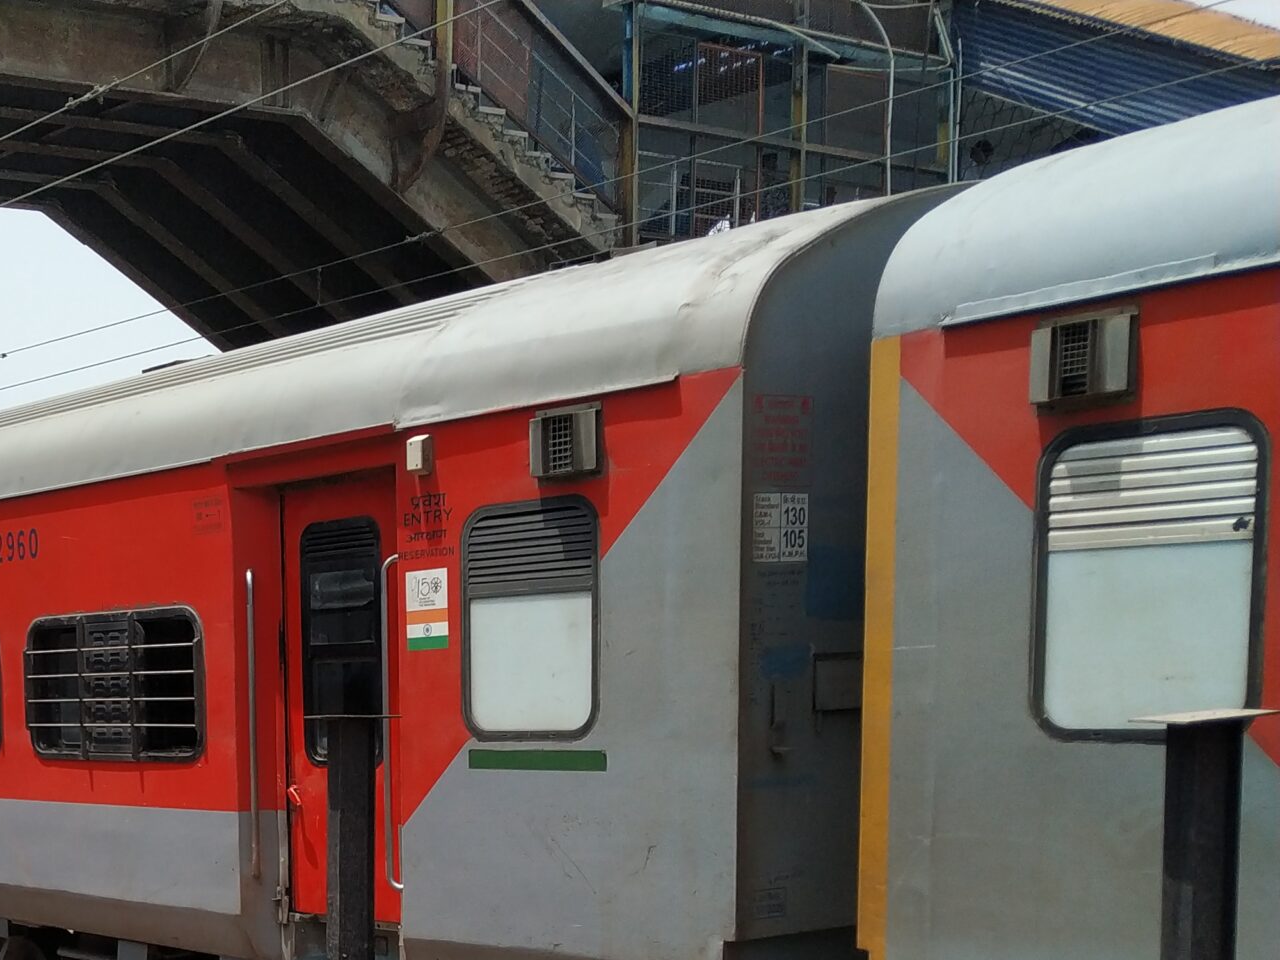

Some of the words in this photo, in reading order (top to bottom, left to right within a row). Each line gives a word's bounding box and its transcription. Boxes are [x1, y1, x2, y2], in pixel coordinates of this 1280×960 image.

[404, 507, 453, 528] ENTRY
[784, 506, 806, 526] 130
[783, 529, 805, 549] 105
[398, 545, 455, 561] RESERVATION
